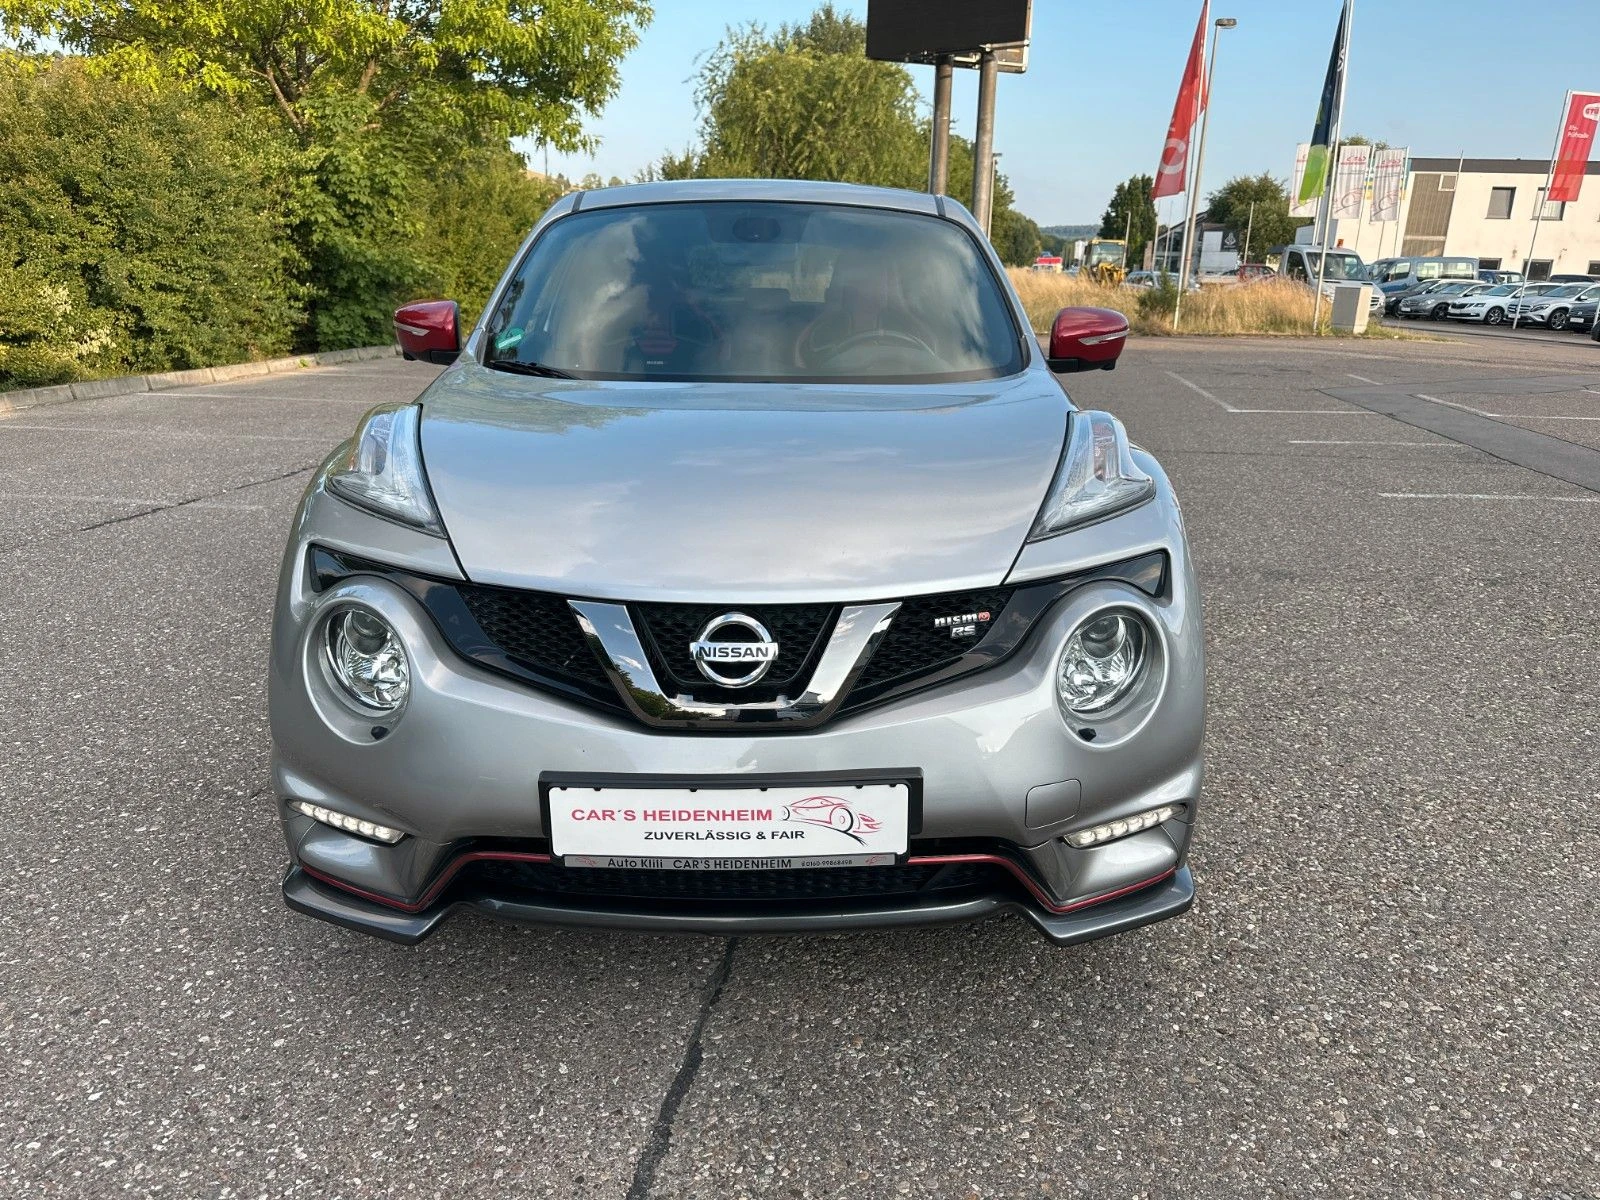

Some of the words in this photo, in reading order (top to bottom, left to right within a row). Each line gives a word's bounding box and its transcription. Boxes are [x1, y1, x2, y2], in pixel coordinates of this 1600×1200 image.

[951, 625, 976, 638] RS
[698, 646, 769, 658] NISSAN
[643, 809, 772, 821] HEIDENHEIM
[644, 829, 751, 840] ZUVERLÄSSIG
[756, 831, 766, 840] &
[771, 830, 805, 840] FAIR
[608, 857, 637, 868] Auto
[673, 859, 710, 869] CAR'S
[714, 858, 791, 869] HEIDENHEIM
